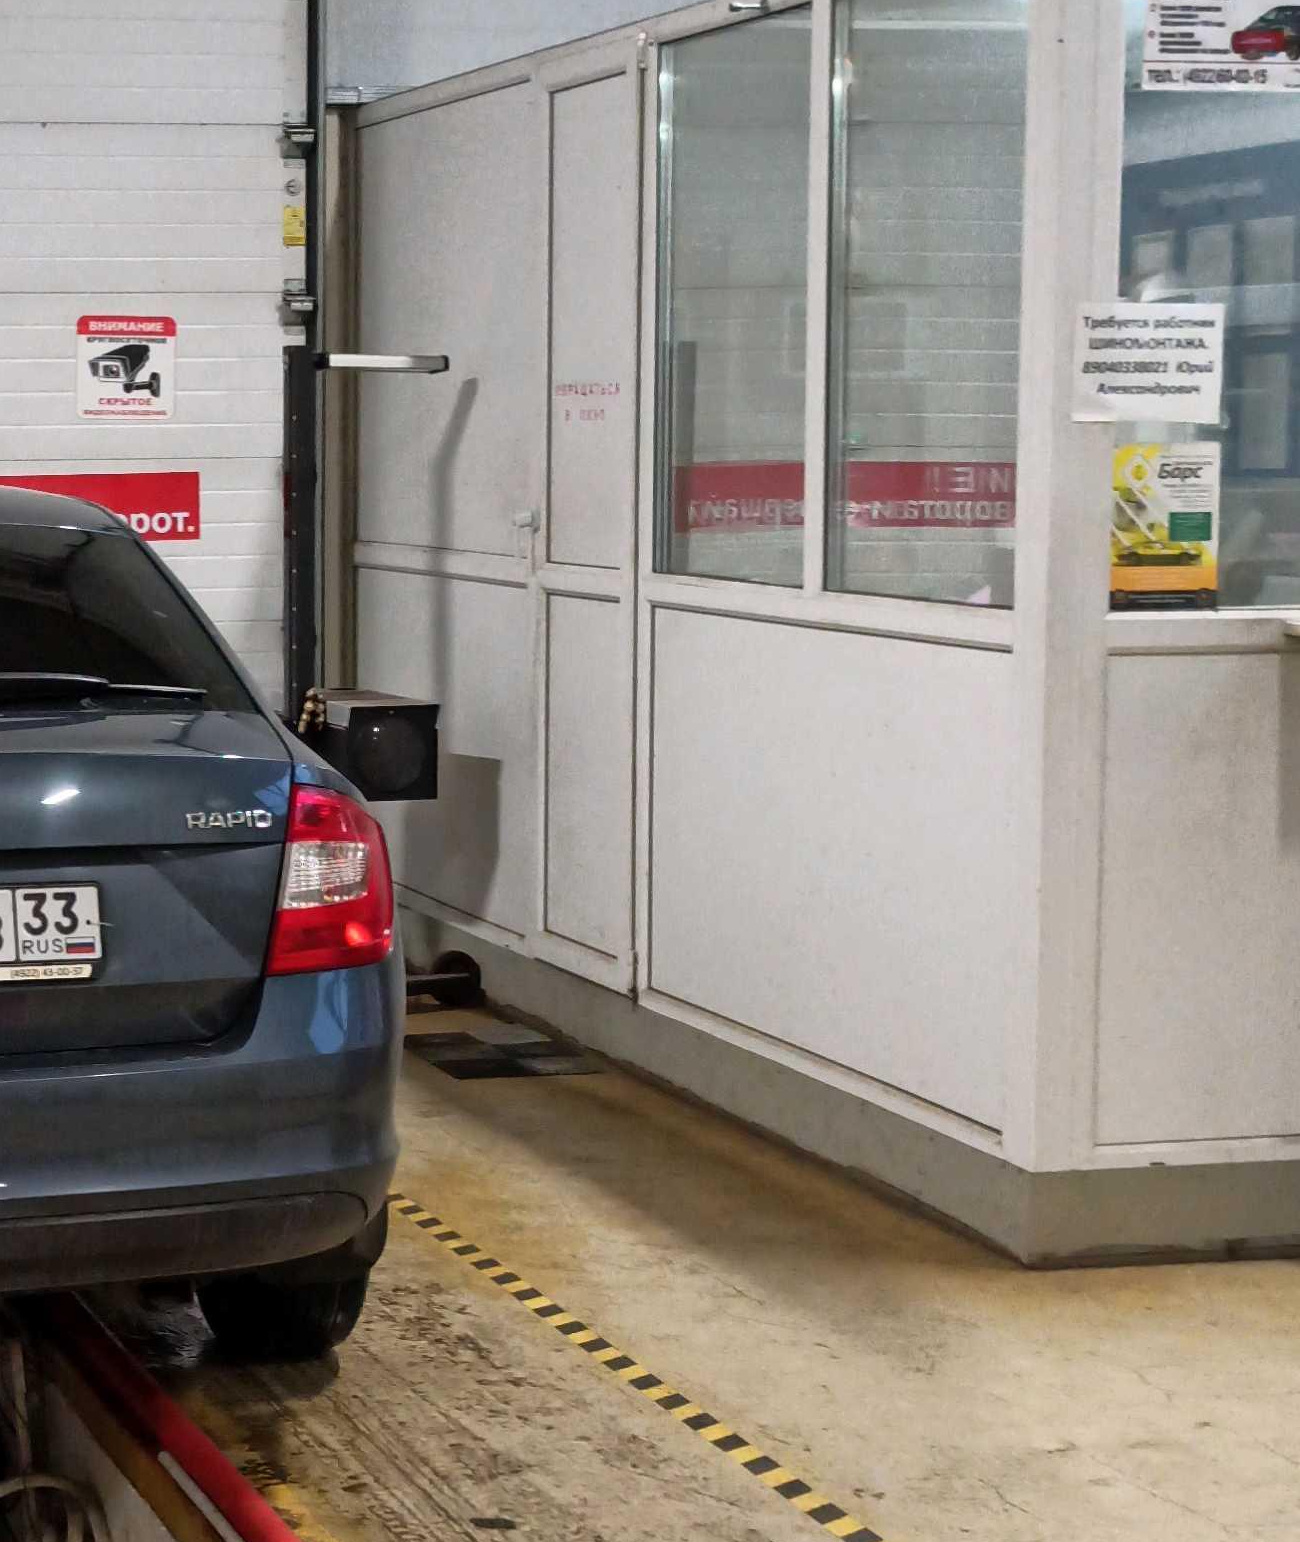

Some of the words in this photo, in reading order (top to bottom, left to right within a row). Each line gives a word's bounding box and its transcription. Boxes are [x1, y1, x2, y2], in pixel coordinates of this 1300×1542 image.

[88, 320, 165, 333] ВНИМАНИЕ
[186, 809, 273, 830] RAPID
[22, 891, 79, 936] 33
[21, 938, 64, 955] RUS
